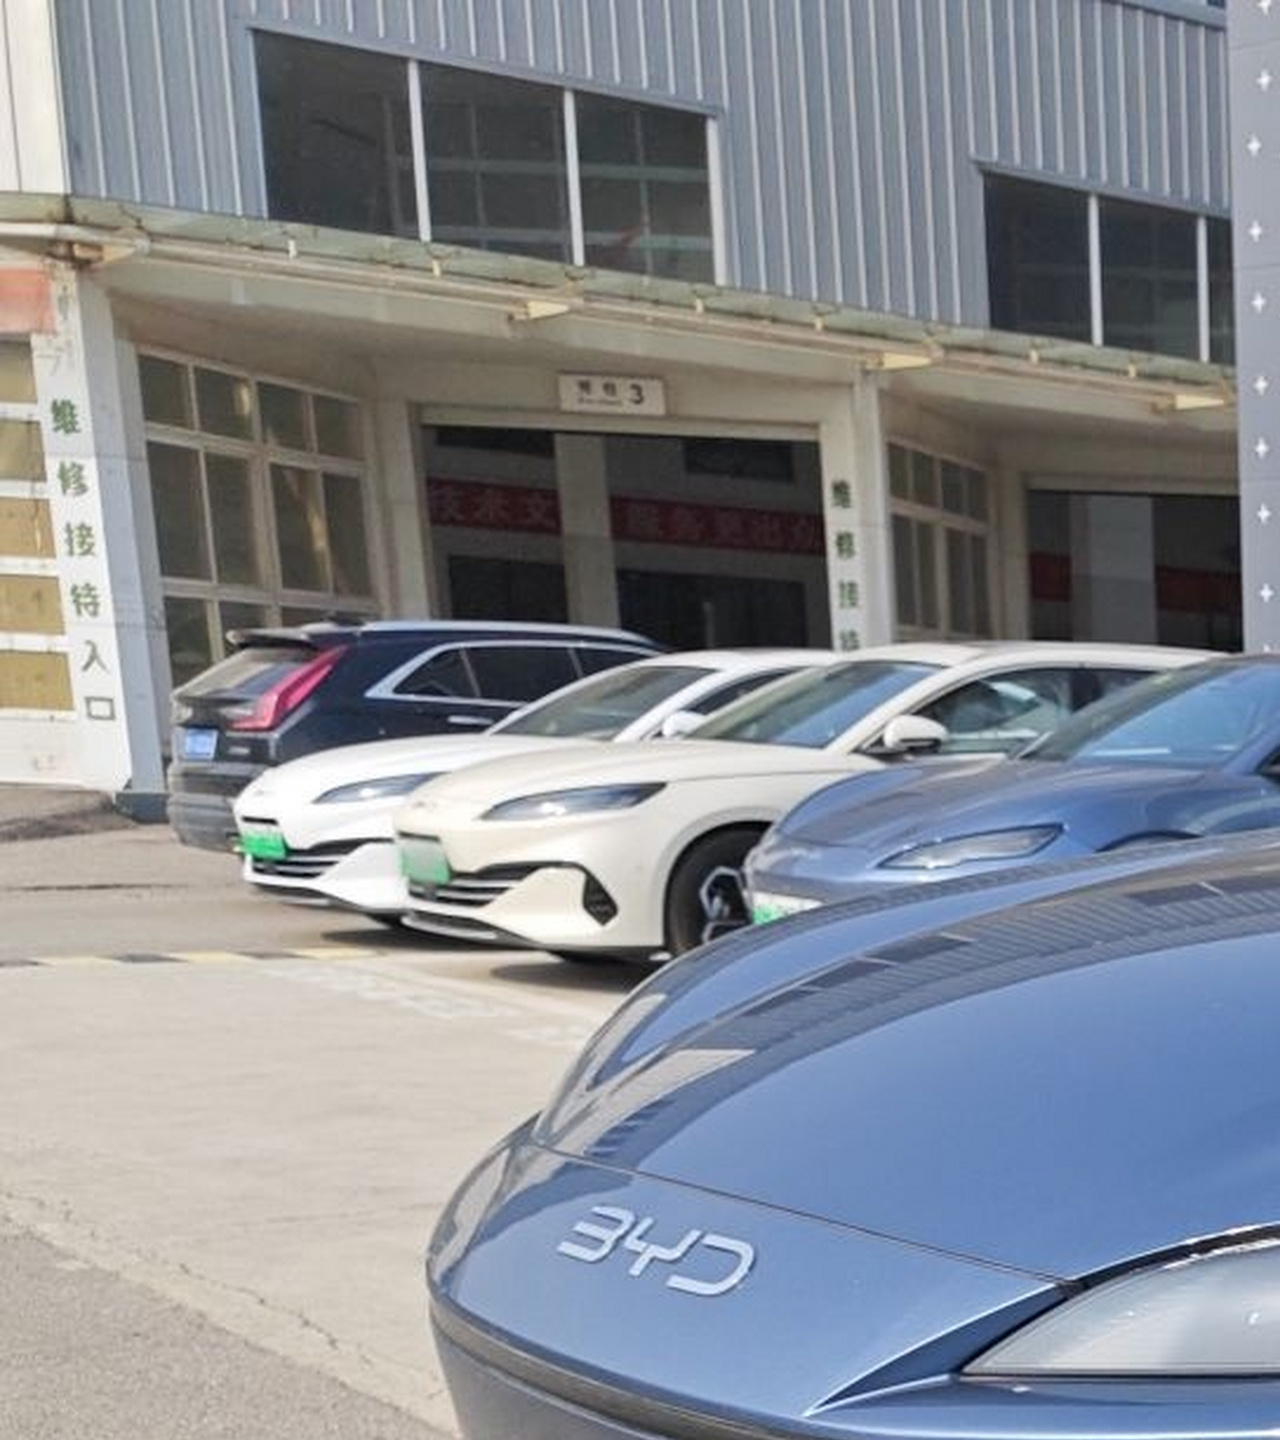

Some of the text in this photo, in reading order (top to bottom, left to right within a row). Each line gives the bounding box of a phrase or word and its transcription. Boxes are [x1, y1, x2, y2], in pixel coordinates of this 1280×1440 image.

[50, 399, 116, 722] 维修接待入口
[556, 1204, 755, 1297] BYD
